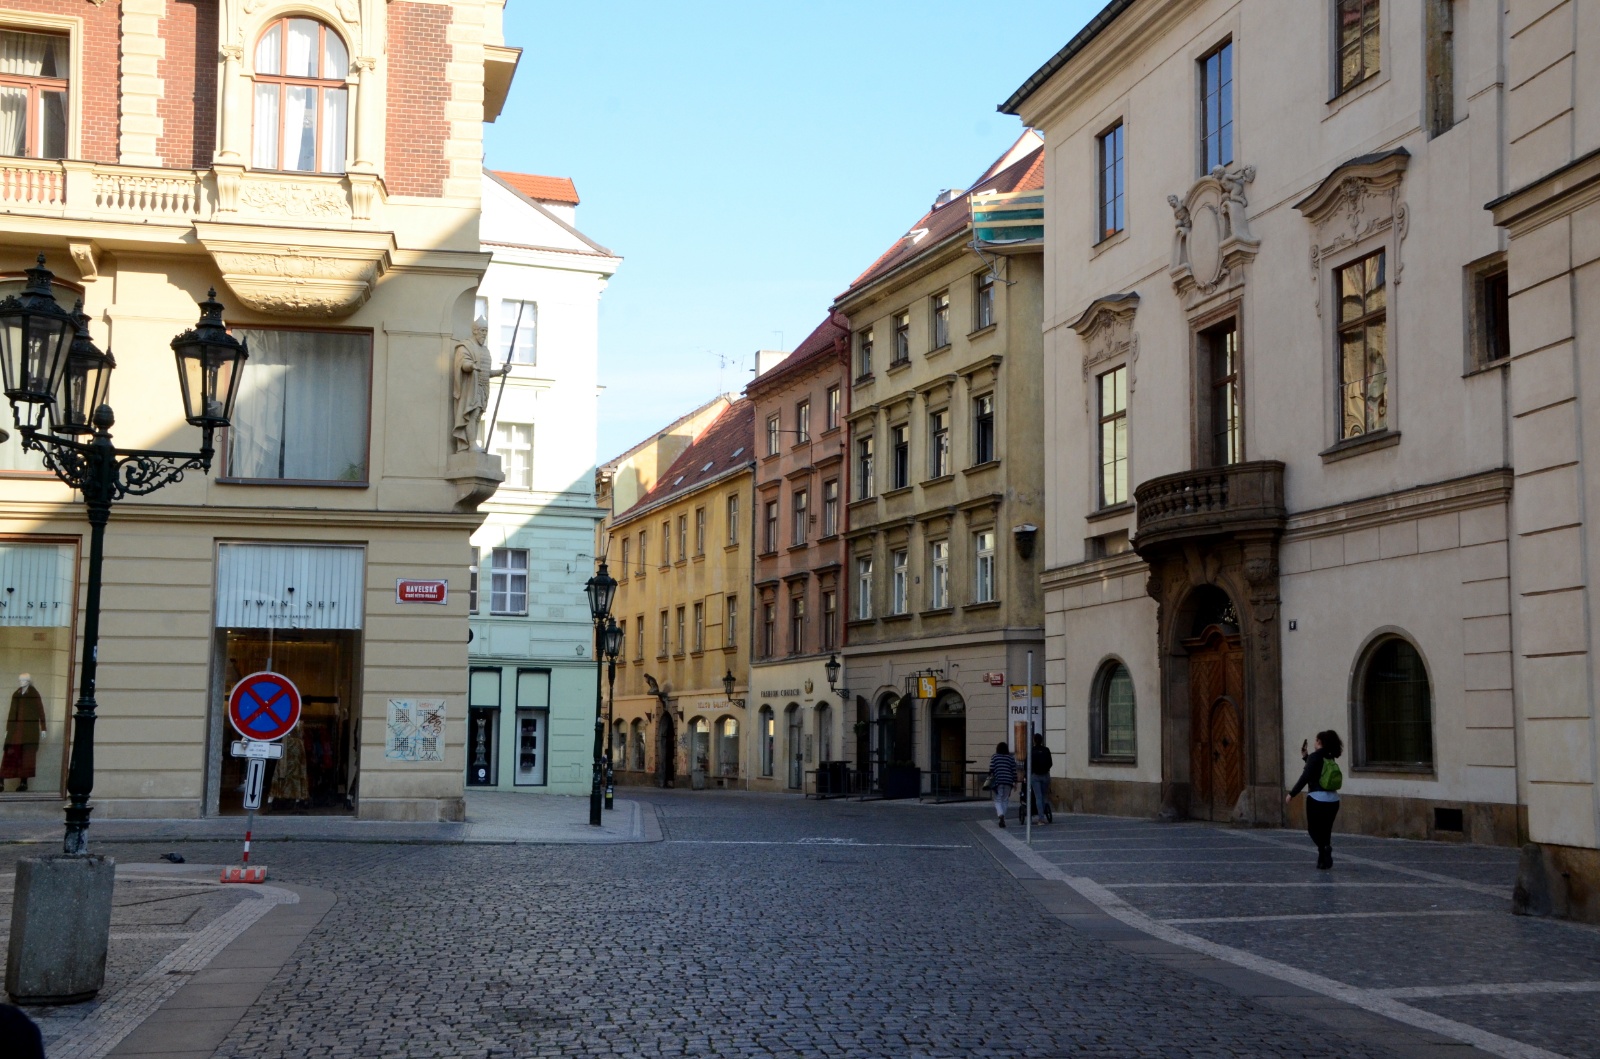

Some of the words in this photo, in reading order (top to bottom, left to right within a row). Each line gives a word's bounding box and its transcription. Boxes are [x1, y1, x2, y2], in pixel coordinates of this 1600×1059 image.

[406, 585, 437, 593] HAVELSKÁ
[27, 601, 60, 609] SET
[1011, 706, 1038, 714] FRAFEE
